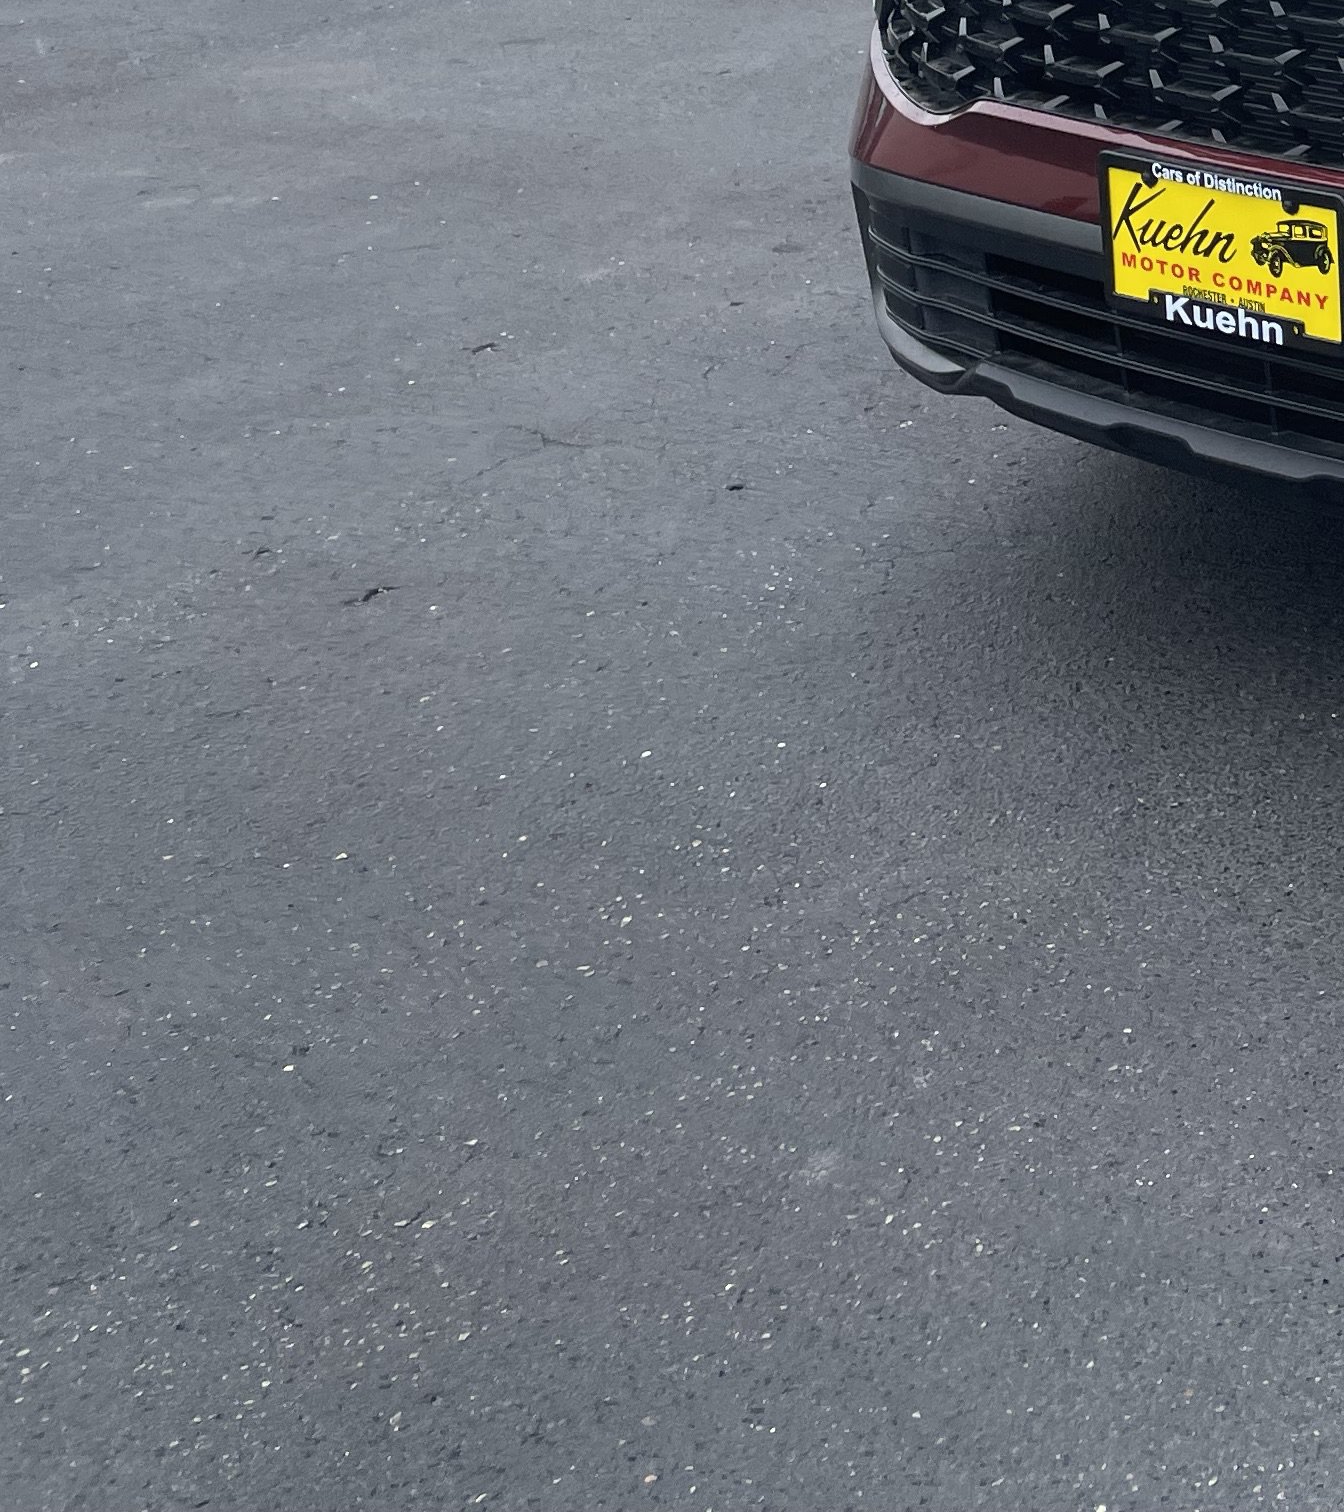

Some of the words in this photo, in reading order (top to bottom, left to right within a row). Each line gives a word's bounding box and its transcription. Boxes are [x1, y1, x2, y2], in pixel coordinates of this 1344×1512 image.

[1151, 162, 1184, 183] Cars
[1186, 170, 1201, 186] of
[1203, 173, 1282, 201] Distinction
[1112, 182, 1238, 264] Kuehn
[1121, 252, 1202, 284] MOTOR
[1212, 273, 1329, 310] COMPANY
[1182, 285, 1228, 305] ROCHESTER
[1238, 299, 1266, 314] AUSTIN
[1165, 294, 1284, 346] Kuehn
